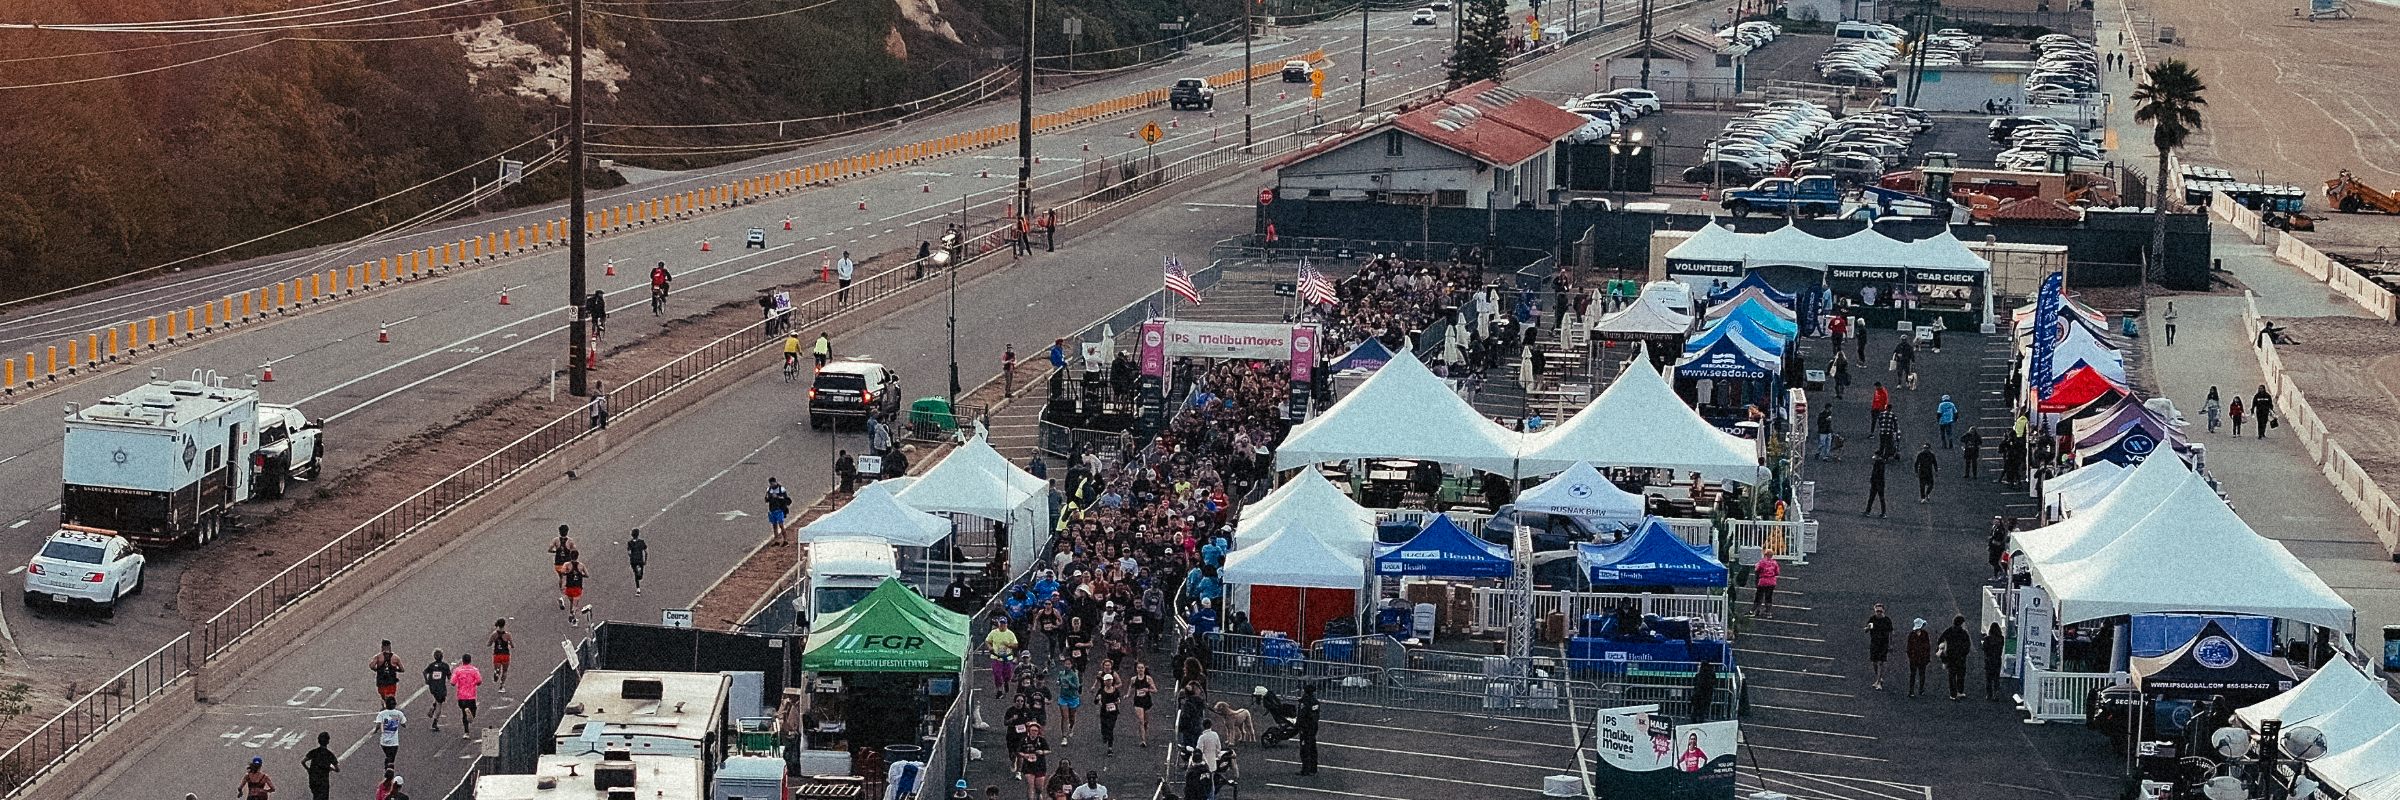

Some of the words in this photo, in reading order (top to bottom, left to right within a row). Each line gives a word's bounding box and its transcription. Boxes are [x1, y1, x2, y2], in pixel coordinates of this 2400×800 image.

[1675, 263, 1734, 272] VOLUNTEERS
[1833, 269, 1860, 278] SHIRT
[1862, 270, 1884, 279] PICK
[1886, 271, 1899, 279] UP
[1916, 272, 1941, 281] GEAR
[1943, 273, 1974, 282] CHECK
[1171, 333, 1189, 343] IPS
[1681, 369, 1764, 378] www.seadon.co
[1550, 505, 1585, 515] RUSNAK
[1586, 508, 1607, 516] BMW
[1443, 552, 1485, 560] Health
[667, 612, 689, 620] Course
[863, 635, 925, 650] FGR
[1628, 652, 1653, 661] Health
[834, 659, 854, 667] ACTIVE
[854, 659, 878, 667] HEALTHY
[879, 659, 907, 668] LIFESTYLE
[907, 659, 929, 668] EVENTS
[1602, 714, 1617, 727] IPS
[1650, 720, 1669, 730] HALF
